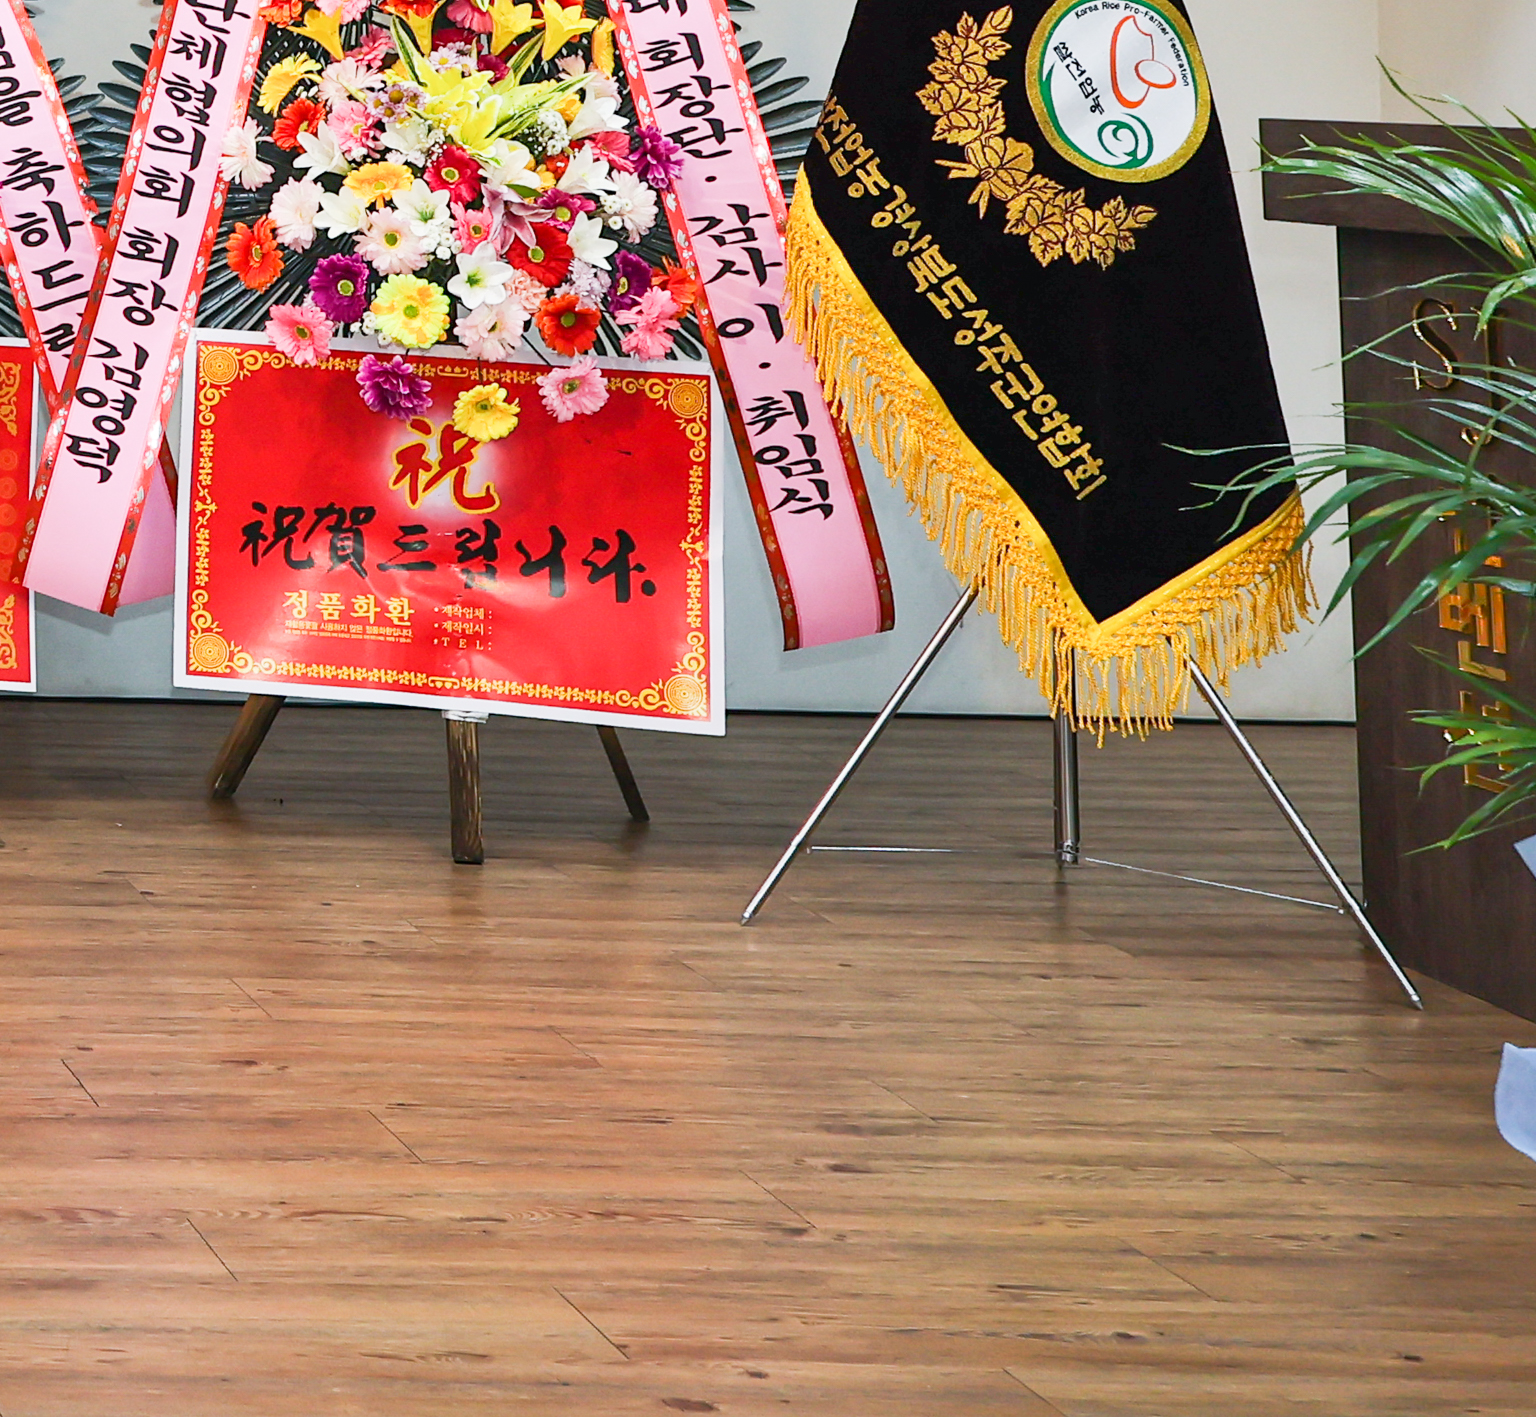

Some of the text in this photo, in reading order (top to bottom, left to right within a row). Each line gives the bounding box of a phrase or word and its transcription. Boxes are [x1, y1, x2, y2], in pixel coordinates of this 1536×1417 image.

[1053, 42, 1105, 115] 쌀전업농
[1074, 1, 1190, 87] Korea Rice Pro-Farmer Federation
[814, 89, 1107, 501] 전업농경상북도성주군연합회
[387, 414, 501, 515] 祝
[282, 589, 415, 627] 정품화환
